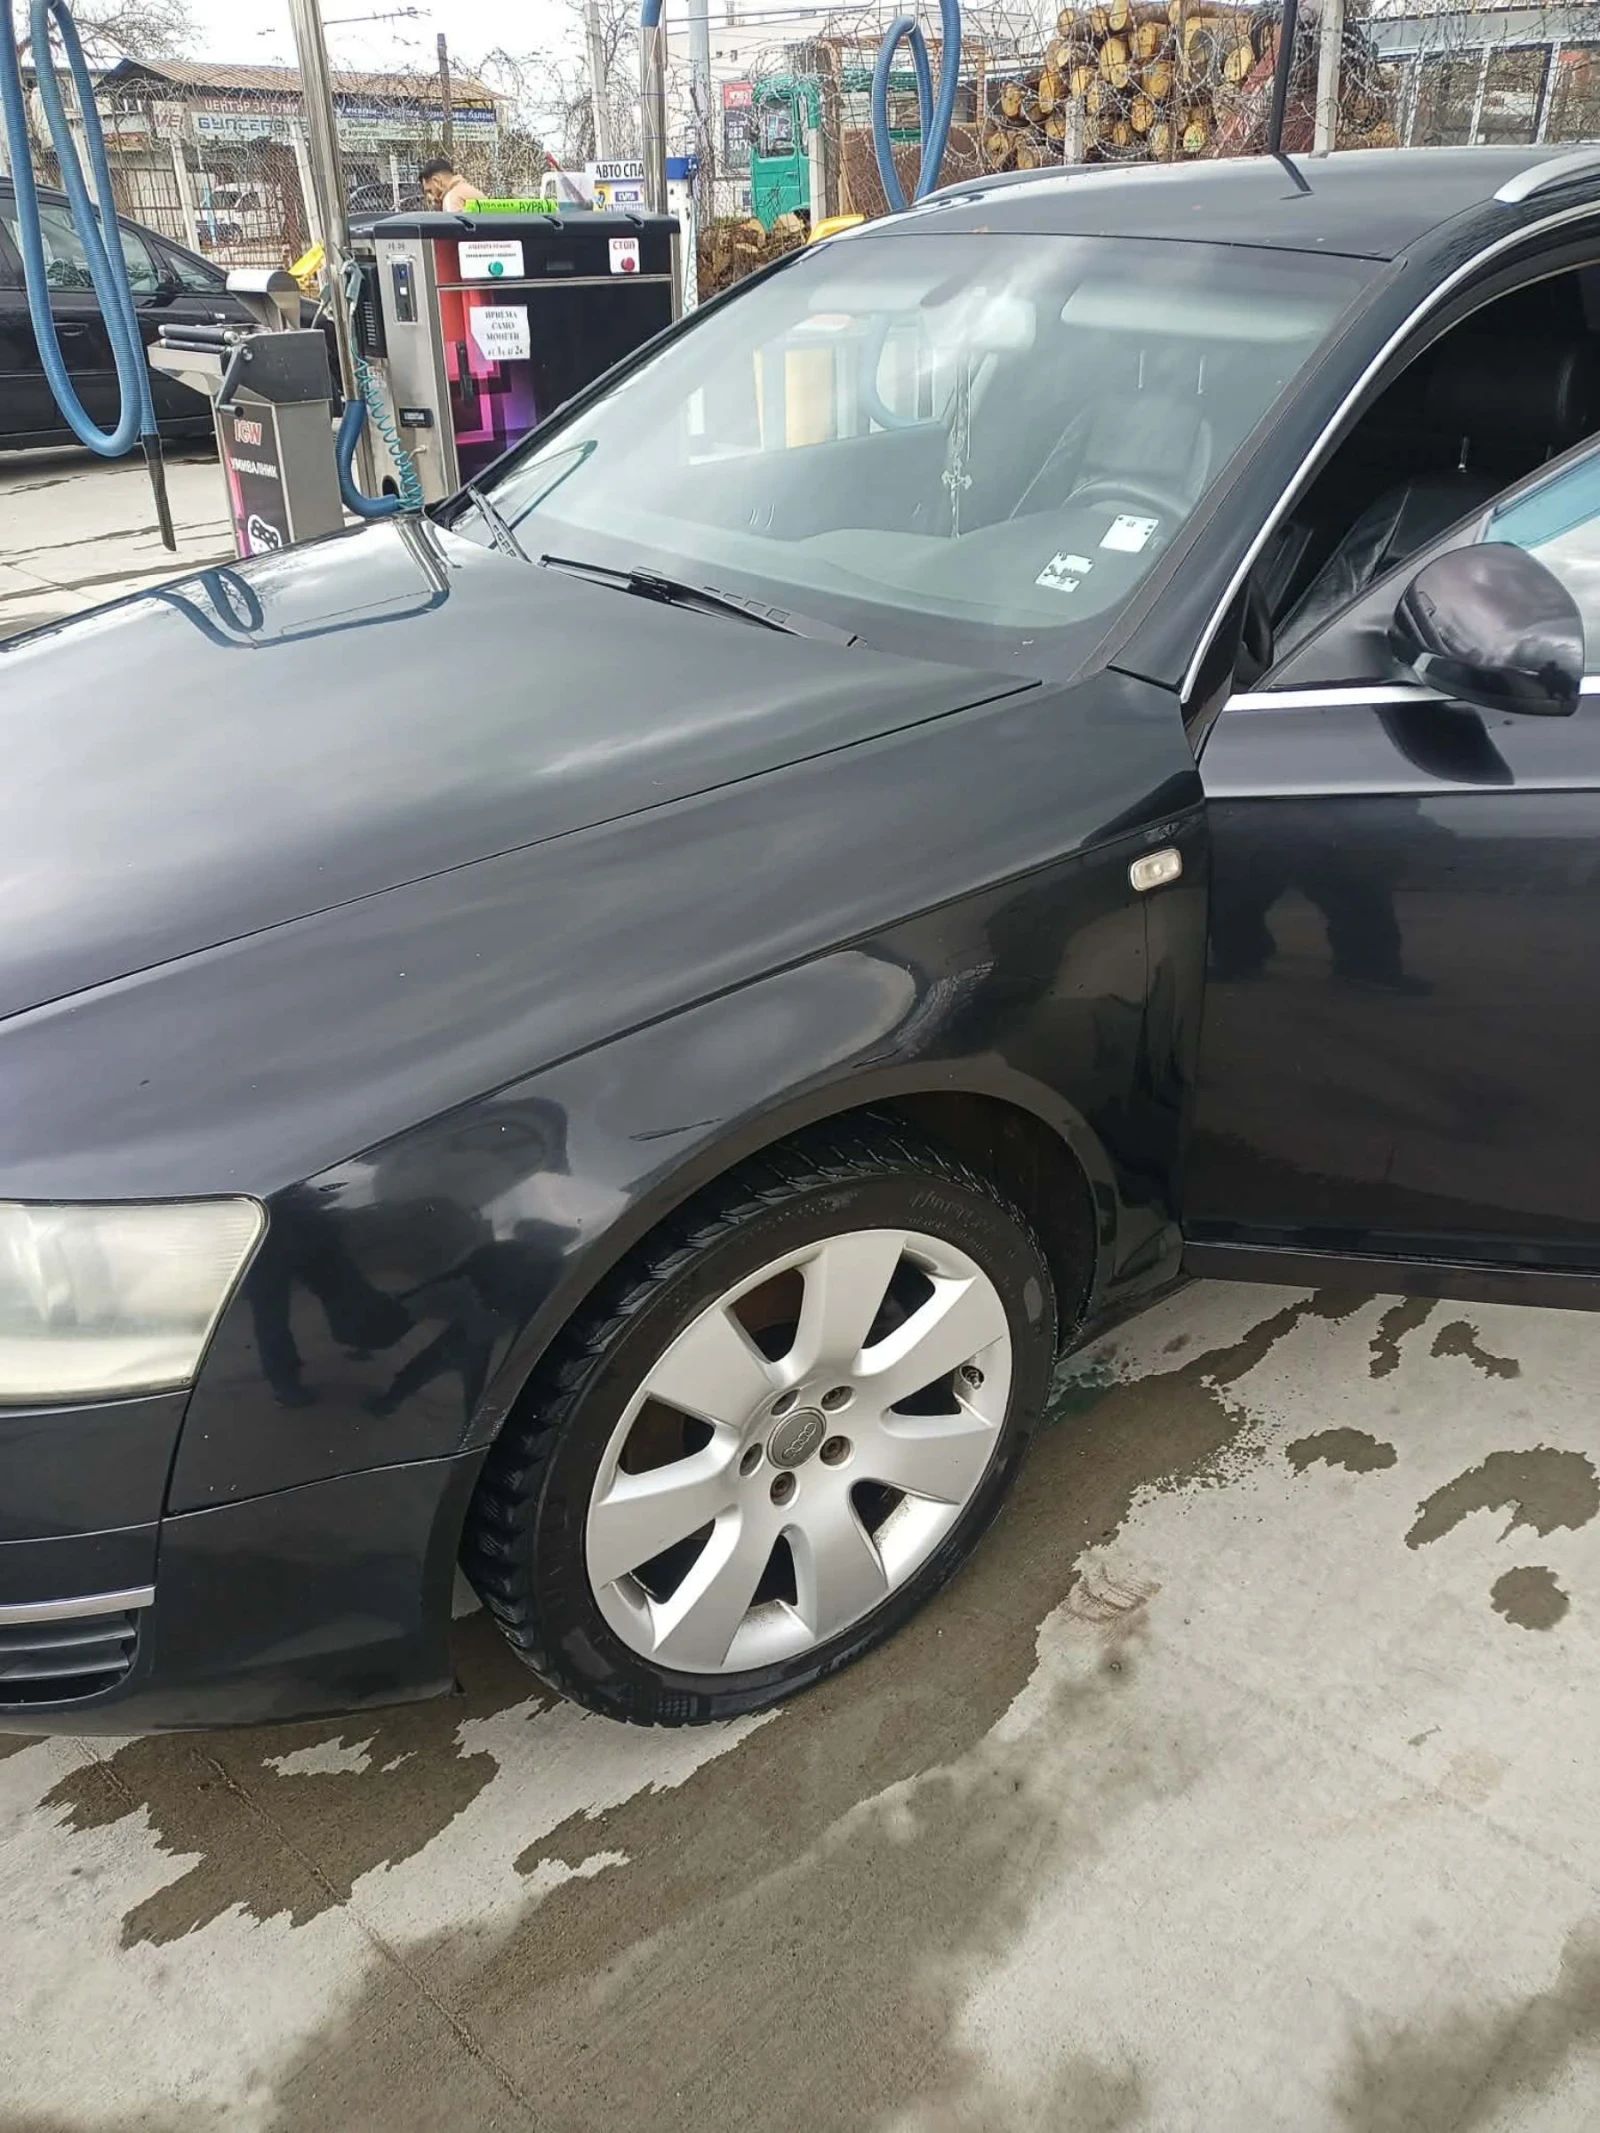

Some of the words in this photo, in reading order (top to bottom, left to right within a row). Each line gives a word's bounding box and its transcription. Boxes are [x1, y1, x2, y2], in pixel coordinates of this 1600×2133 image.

[253, 101, 268, 113] ЗА
[596, 163, 622, 178] АВТО
[491, 321, 515, 330] САМО
